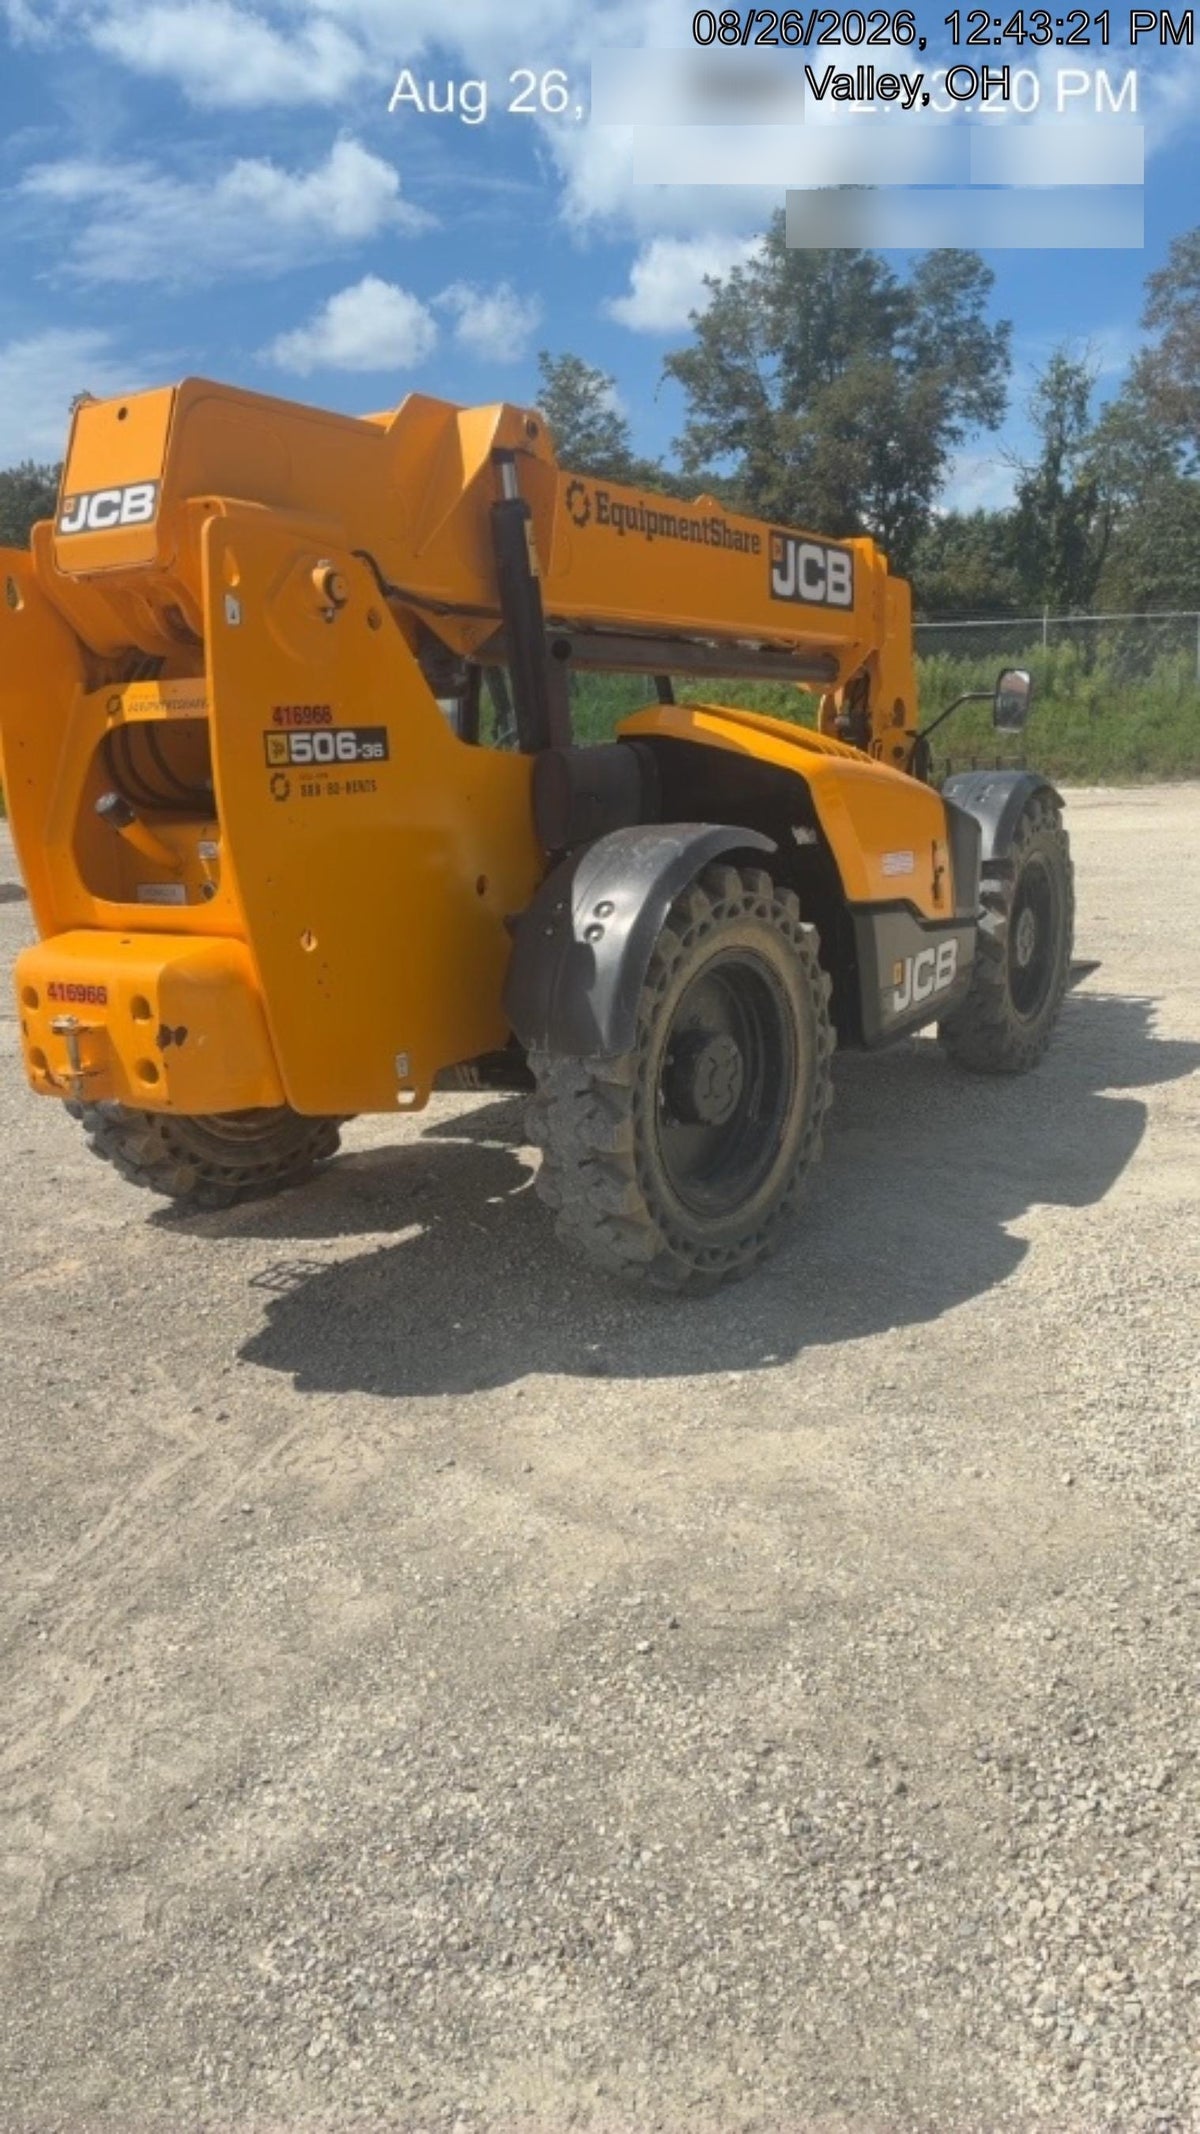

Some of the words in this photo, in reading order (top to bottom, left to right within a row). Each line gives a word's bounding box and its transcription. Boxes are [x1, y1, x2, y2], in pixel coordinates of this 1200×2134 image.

[60, 484, 156, 532] JCB
[595, 490, 761, 555] EquipmentShare
[772, 539, 853, 606] JCB
[46, 981, 108, 1006] 416966
[892, 936, 958, 1013] JCB
